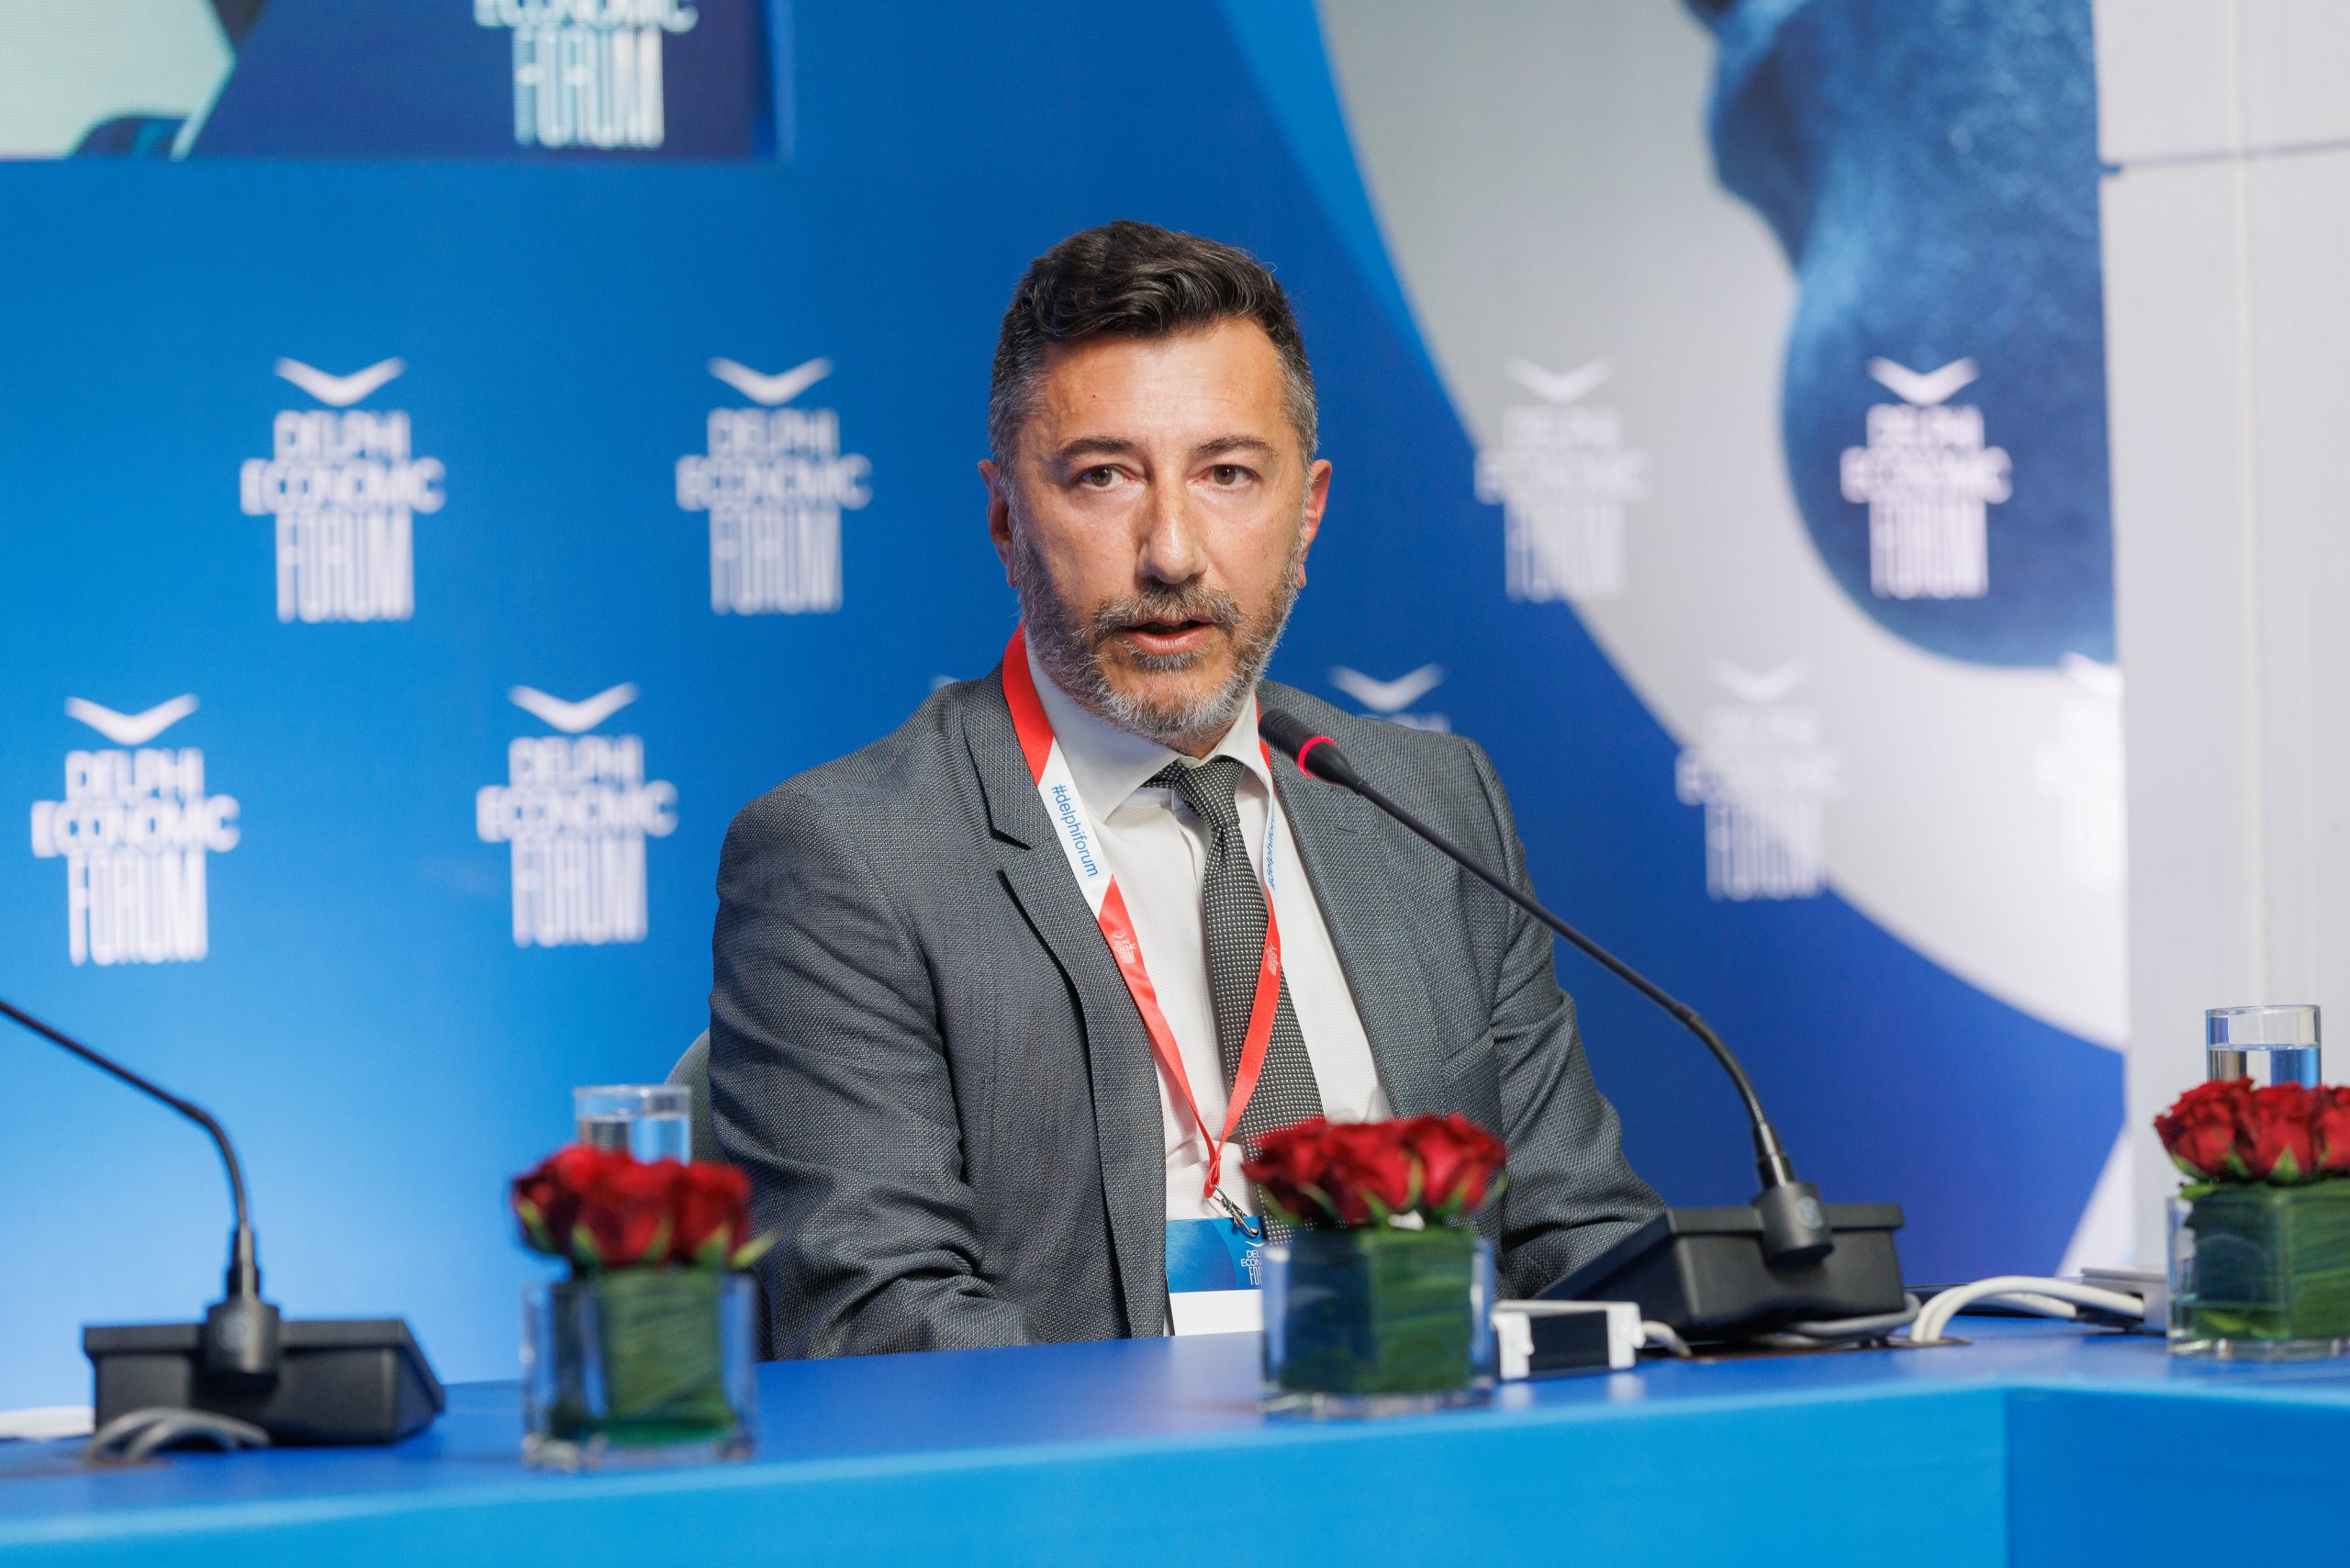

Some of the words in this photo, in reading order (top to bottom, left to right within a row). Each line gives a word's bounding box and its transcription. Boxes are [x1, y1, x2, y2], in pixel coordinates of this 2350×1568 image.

[240, 457, 446, 516] ECONOMIC
[676, 454, 872, 511] ECONOMIC
[30, 794, 241, 857] ECONOMIC
[476, 779, 679, 843] ECONOMIC
[1051, 784, 1099, 878] #delphiforum
[1240, 1258, 1262, 1267] ECON
[1246, 1249, 1262, 1259] DEL
